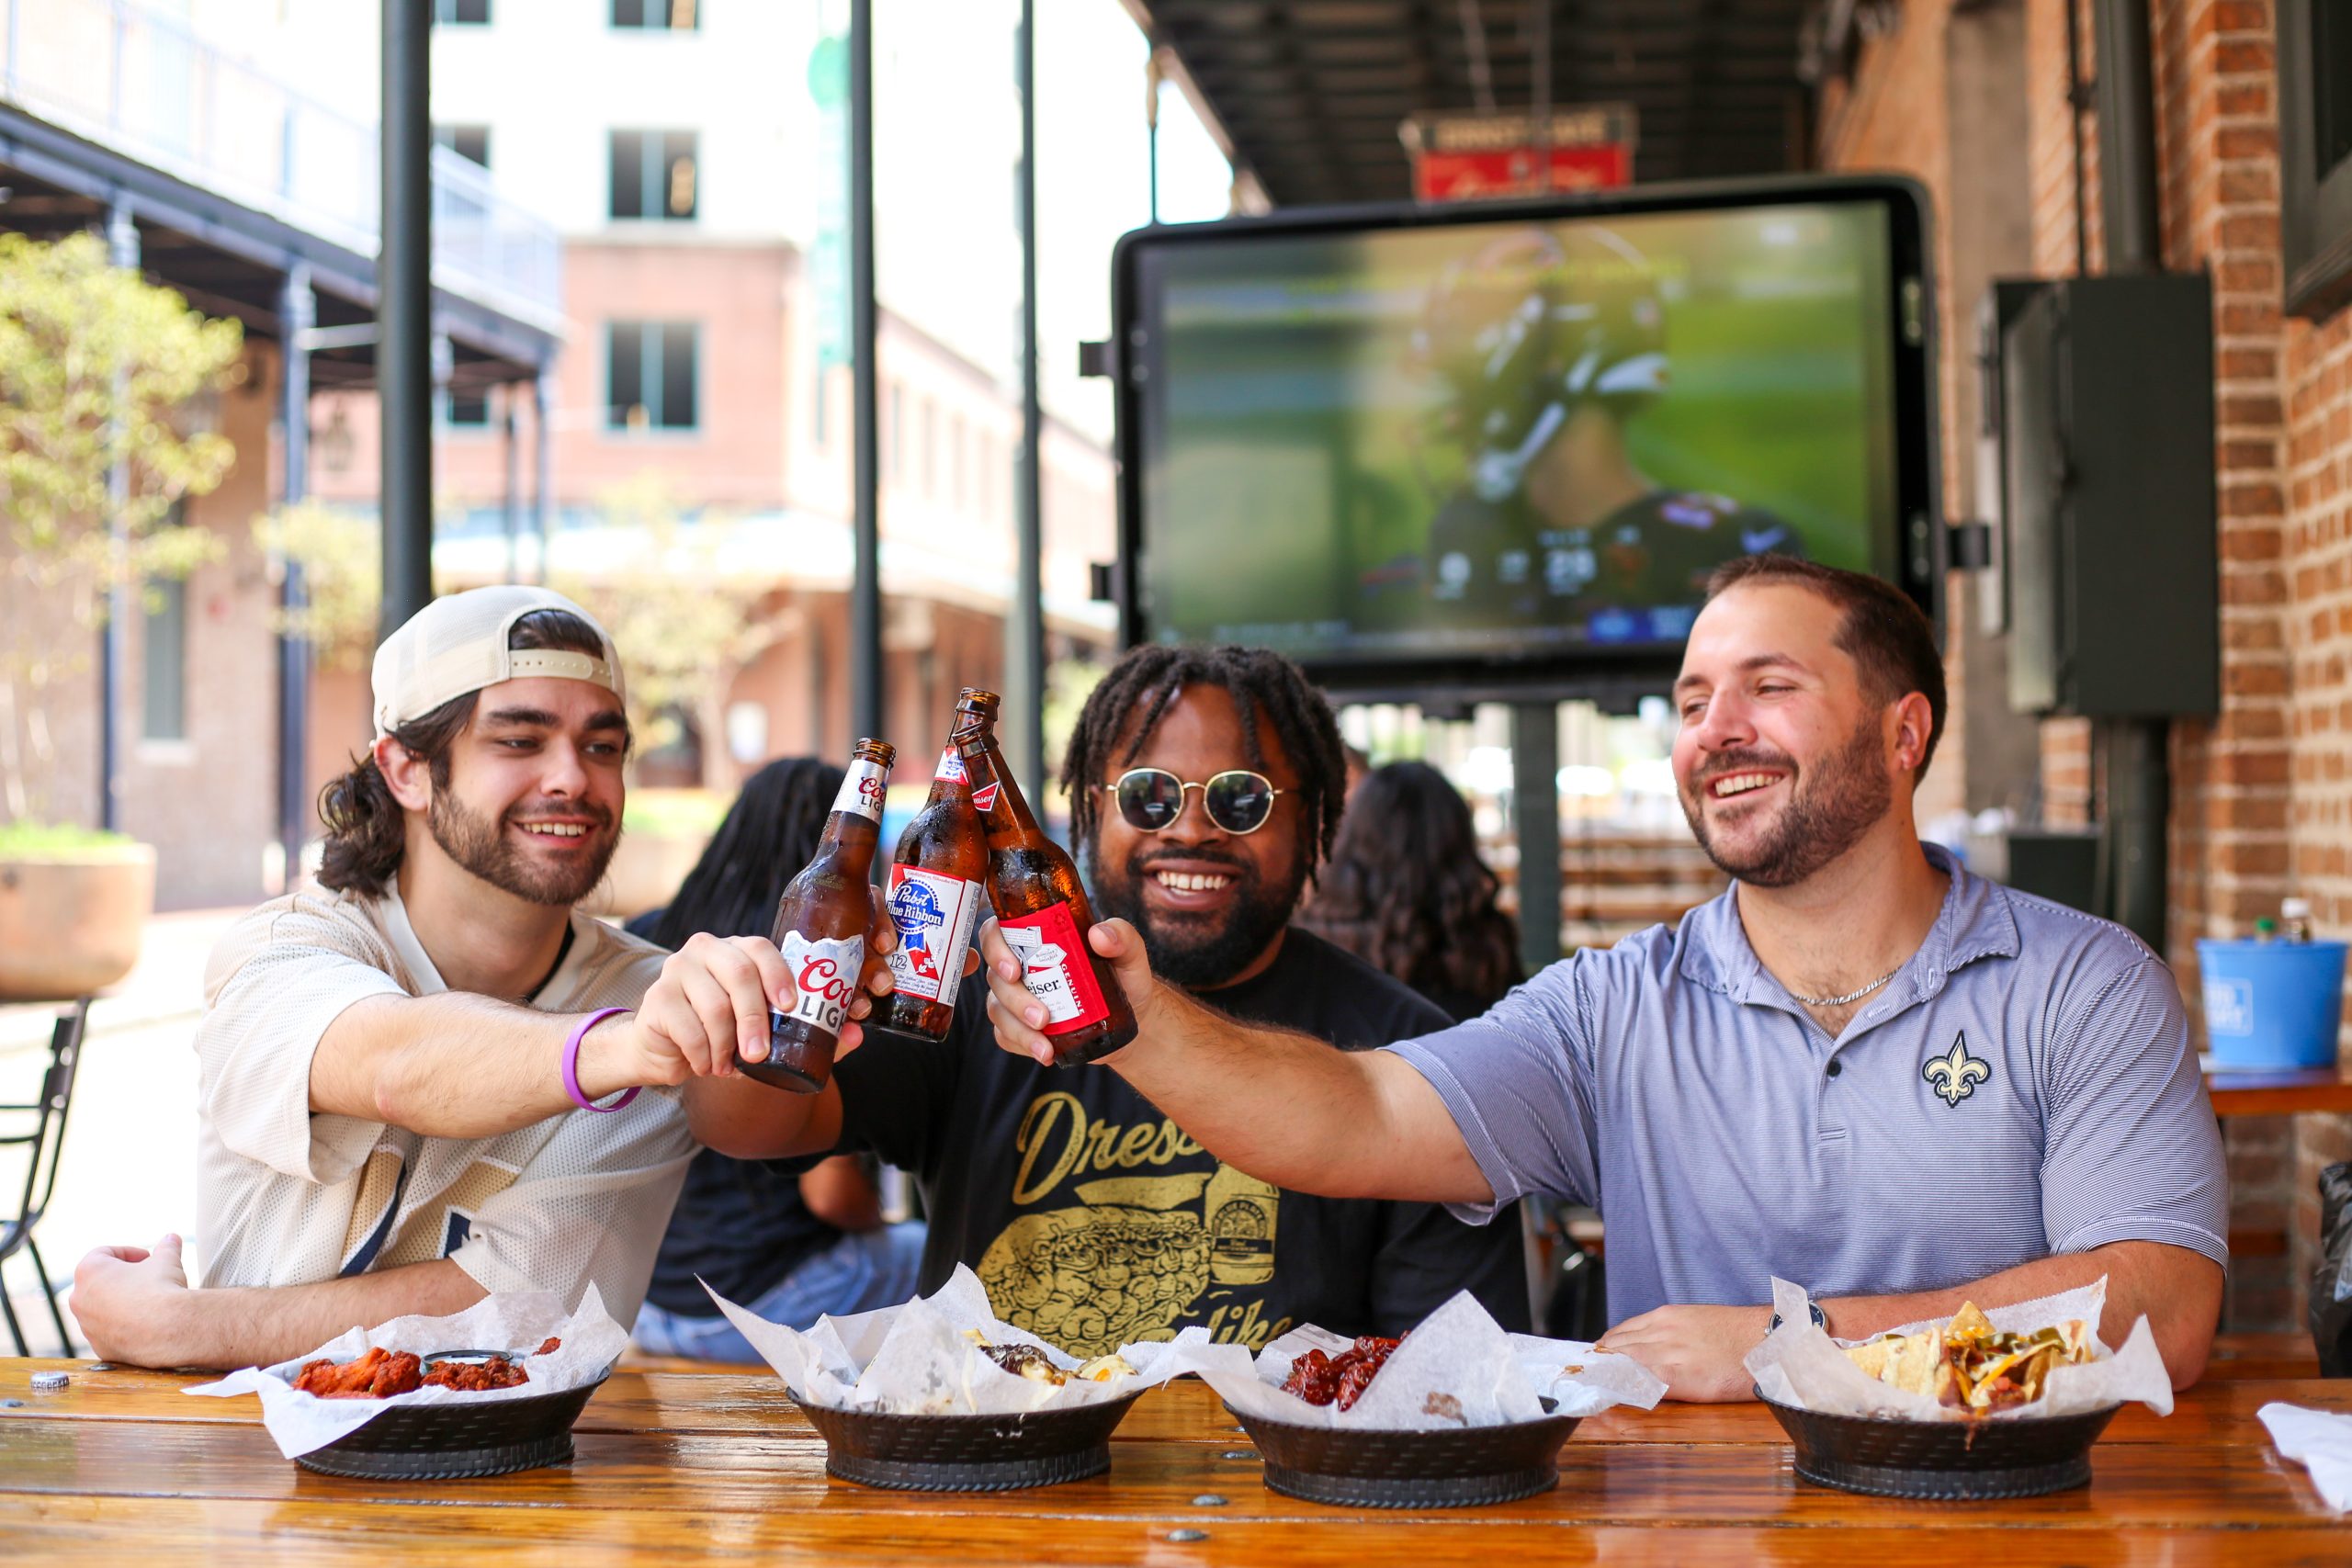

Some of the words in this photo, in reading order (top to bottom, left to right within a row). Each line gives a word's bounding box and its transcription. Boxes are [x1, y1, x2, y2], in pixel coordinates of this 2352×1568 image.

[898, 885, 931, 907] Pabst
[887, 901, 904, 917] Blue
[903, 904, 943, 926] Ribbon
[890, 953, 908, 970] 12
[1061, 963, 1086, 1016] GENUINE
